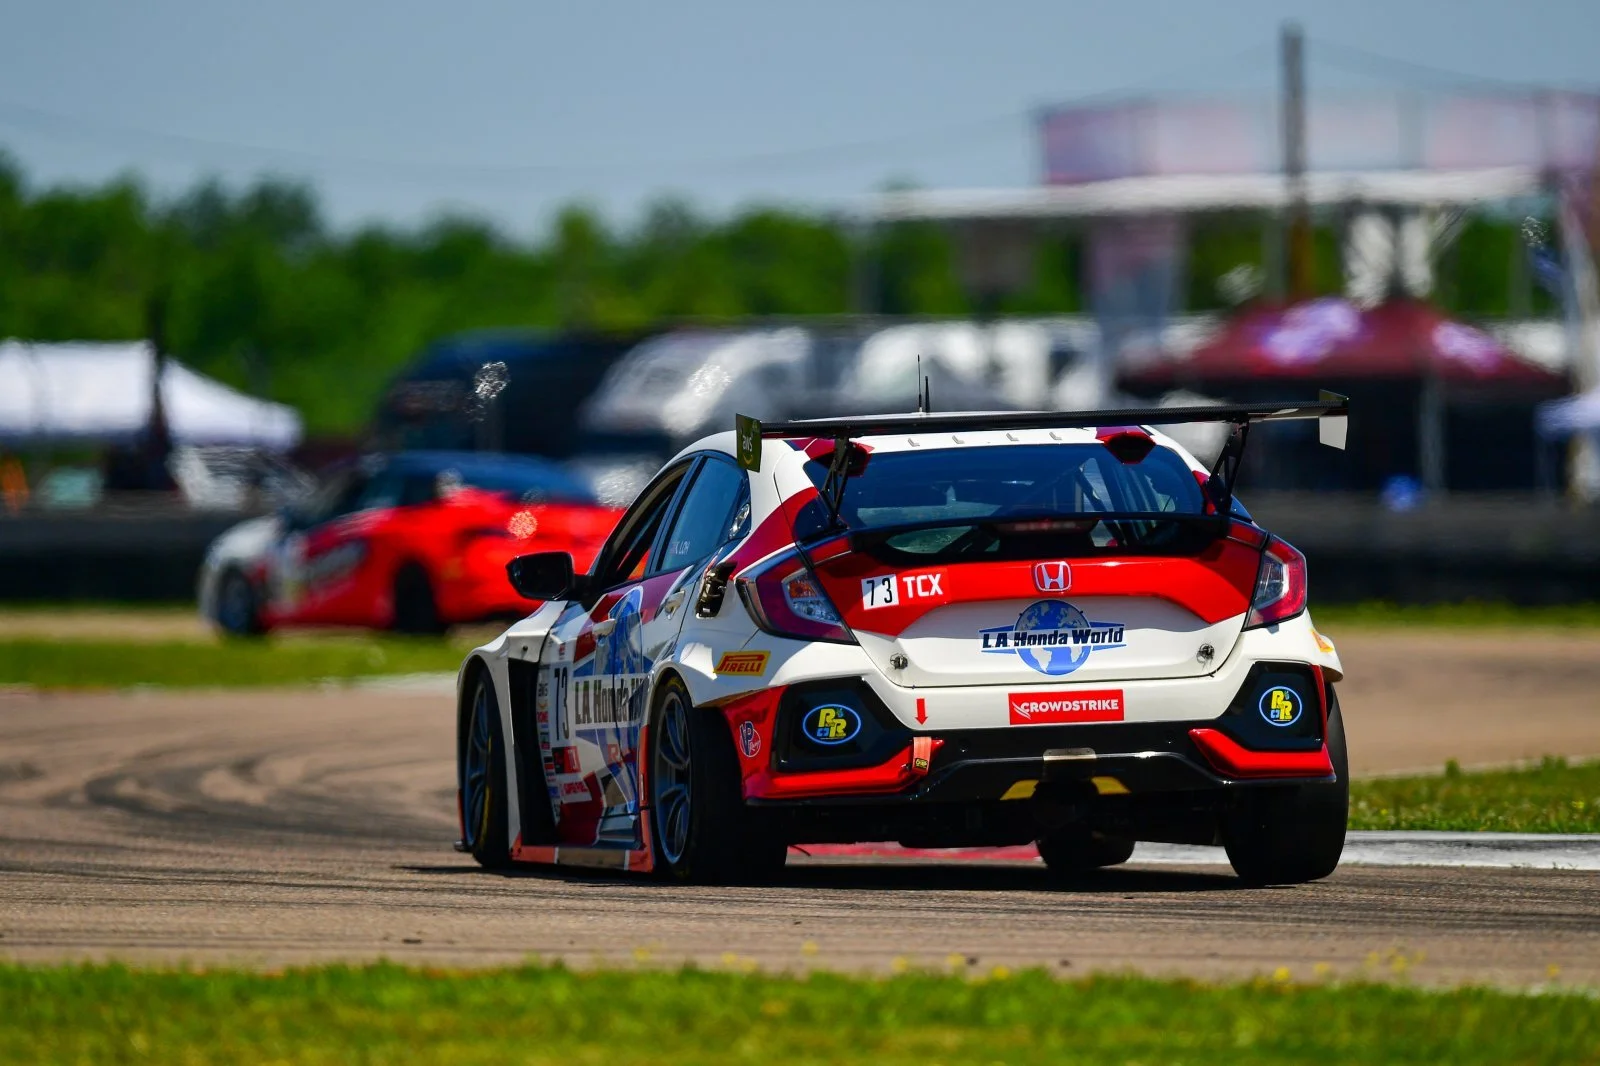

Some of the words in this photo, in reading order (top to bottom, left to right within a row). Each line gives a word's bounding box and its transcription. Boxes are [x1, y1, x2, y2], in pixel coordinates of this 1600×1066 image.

[866, 577, 893, 606] 73
[903, 574, 943, 599] TCX
[982, 633, 1011, 649] L.A.
[1013, 630, 1068, 647] Honda
[1072, 627, 1124, 645] World
[719, 654, 765, 673] PIRELLI
[553, 666, 570, 742] 73
[593, 678, 630, 724] Honda
[1020, 699, 1120, 713] CROWDSTRIKE
